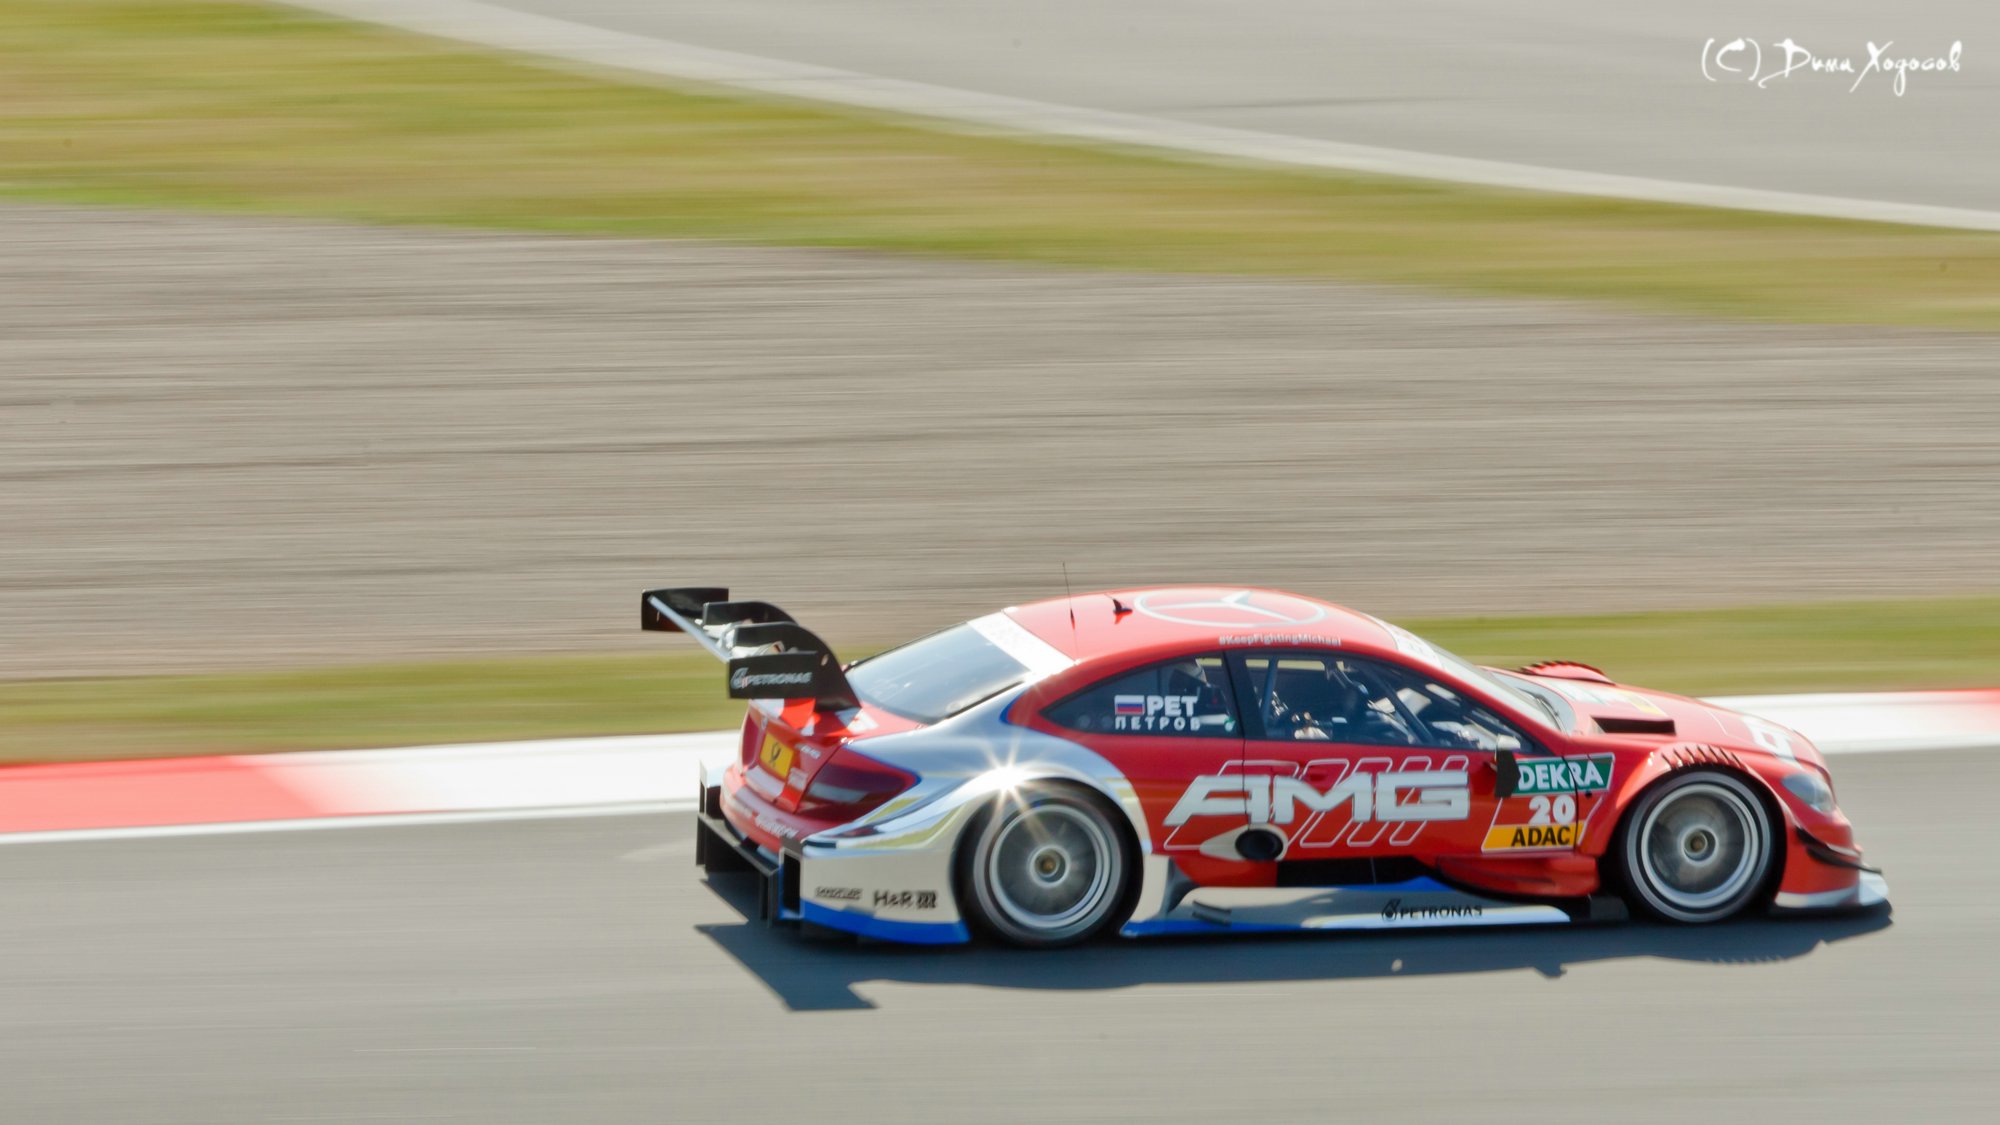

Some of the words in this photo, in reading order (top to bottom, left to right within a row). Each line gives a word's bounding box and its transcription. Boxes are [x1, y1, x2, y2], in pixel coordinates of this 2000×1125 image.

[1115, 715, 1201, 731] ПЕТРОВ
[1517, 759, 1604, 791] DEKRA
[1162, 770, 1470, 826] AMG
[1528, 794, 1576, 825] 20
[1511, 826, 1570, 847] ADAC
[1400, 904, 1483, 919] PETRONAS
